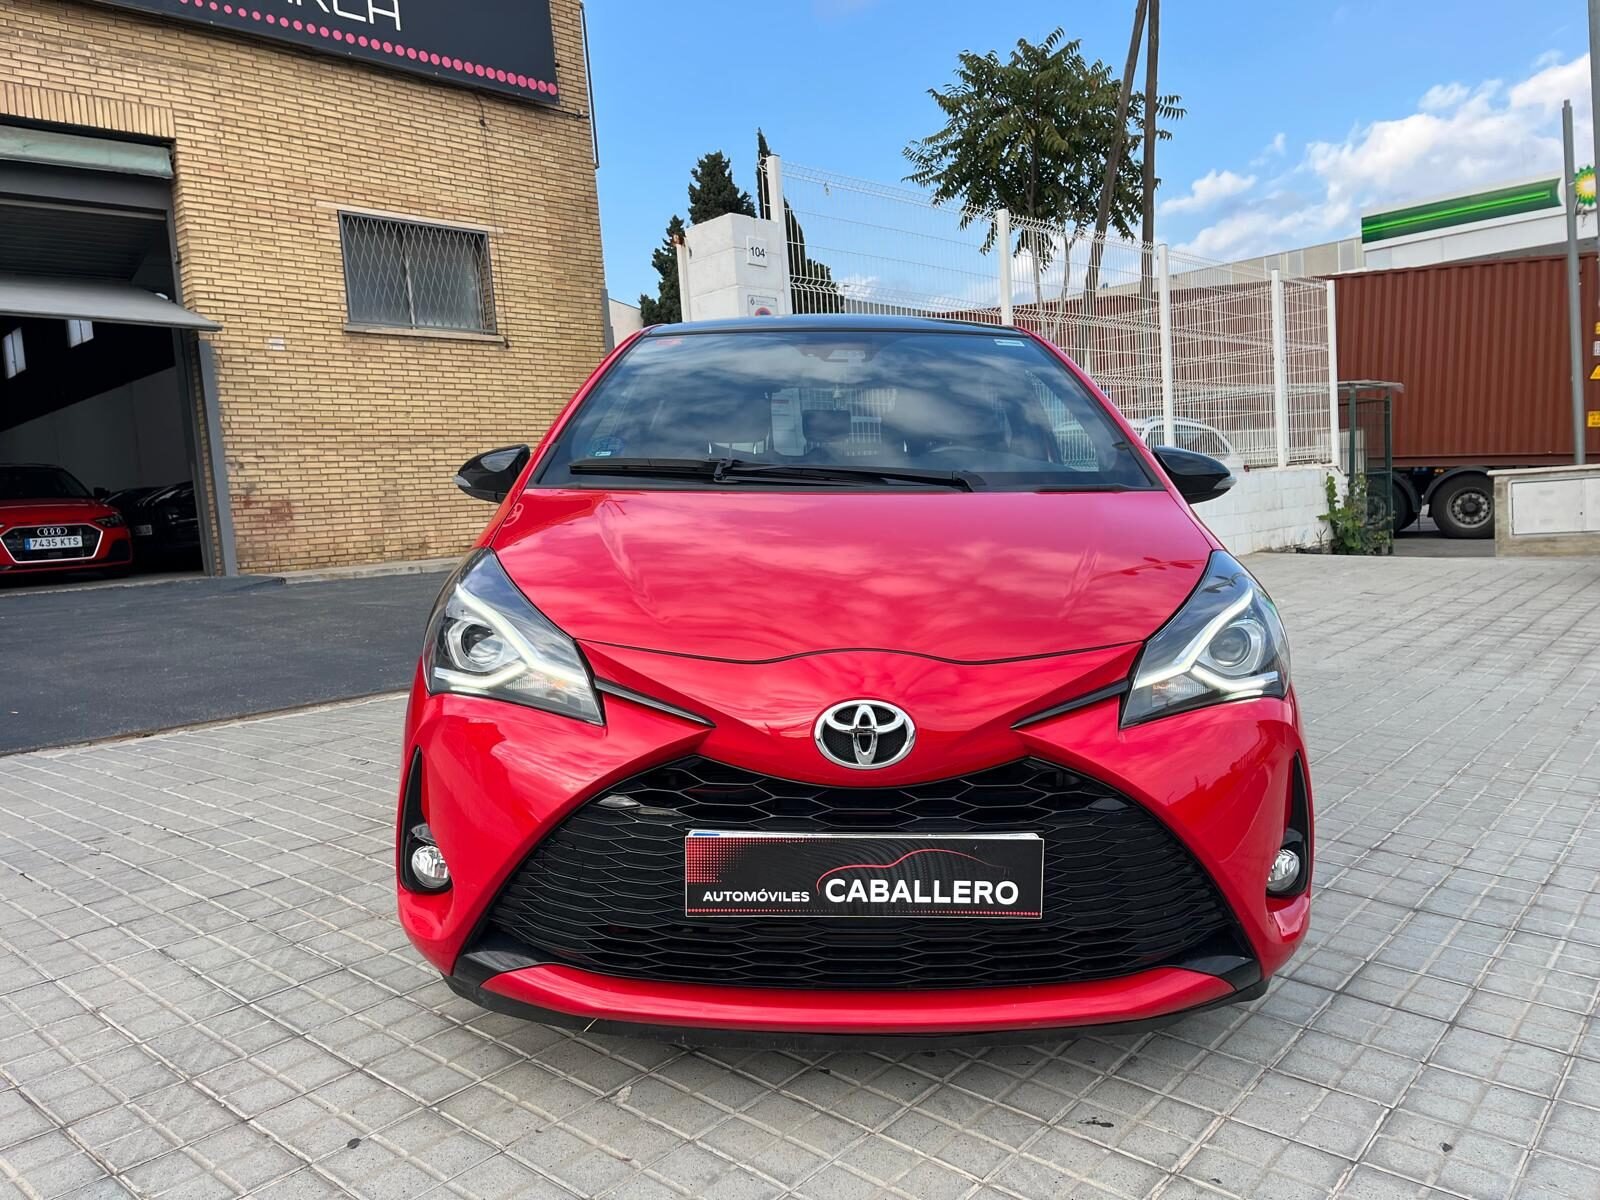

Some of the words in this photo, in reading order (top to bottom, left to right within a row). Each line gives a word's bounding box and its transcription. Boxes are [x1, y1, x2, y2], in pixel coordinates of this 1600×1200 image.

[750, 246, 766, 258] 104
[32, 538, 58, 548] 7435
[60, 536, 79, 547] KTS
[702, 888, 810, 903] AUTOMÓVILES
[824, 878, 1020, 905] CABALLERO
